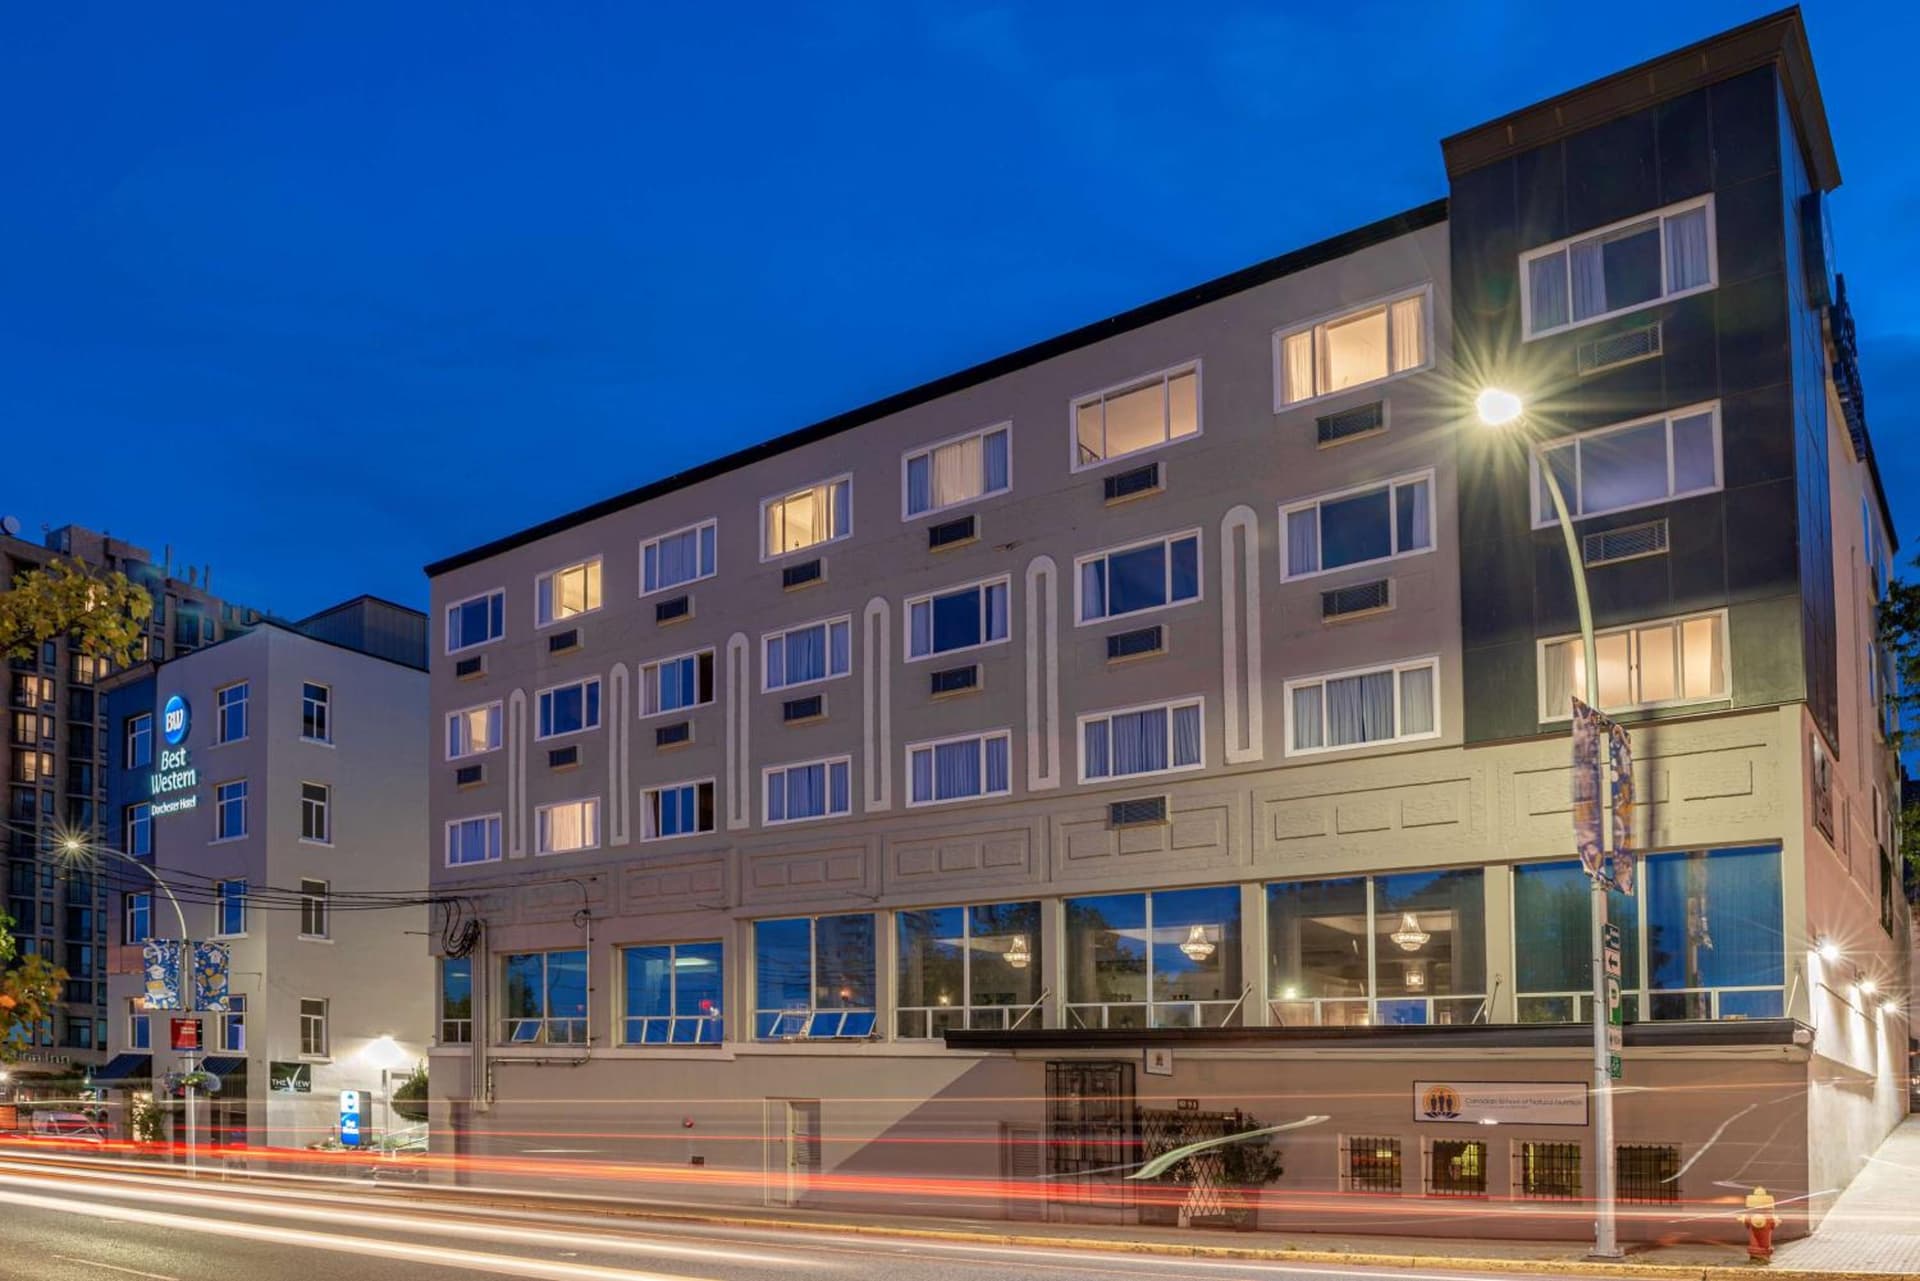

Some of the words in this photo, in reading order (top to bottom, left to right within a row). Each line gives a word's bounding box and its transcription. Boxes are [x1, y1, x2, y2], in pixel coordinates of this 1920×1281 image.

[166, 709, 183, 732] BW
[161, 747, 186, 770] Best
[151, 769, 196, 795] Western
[151, 801, 180, 816] Dorchester
[180, 795, 196, 809] Hotel
[271, 1078, 288, 1087] THE
